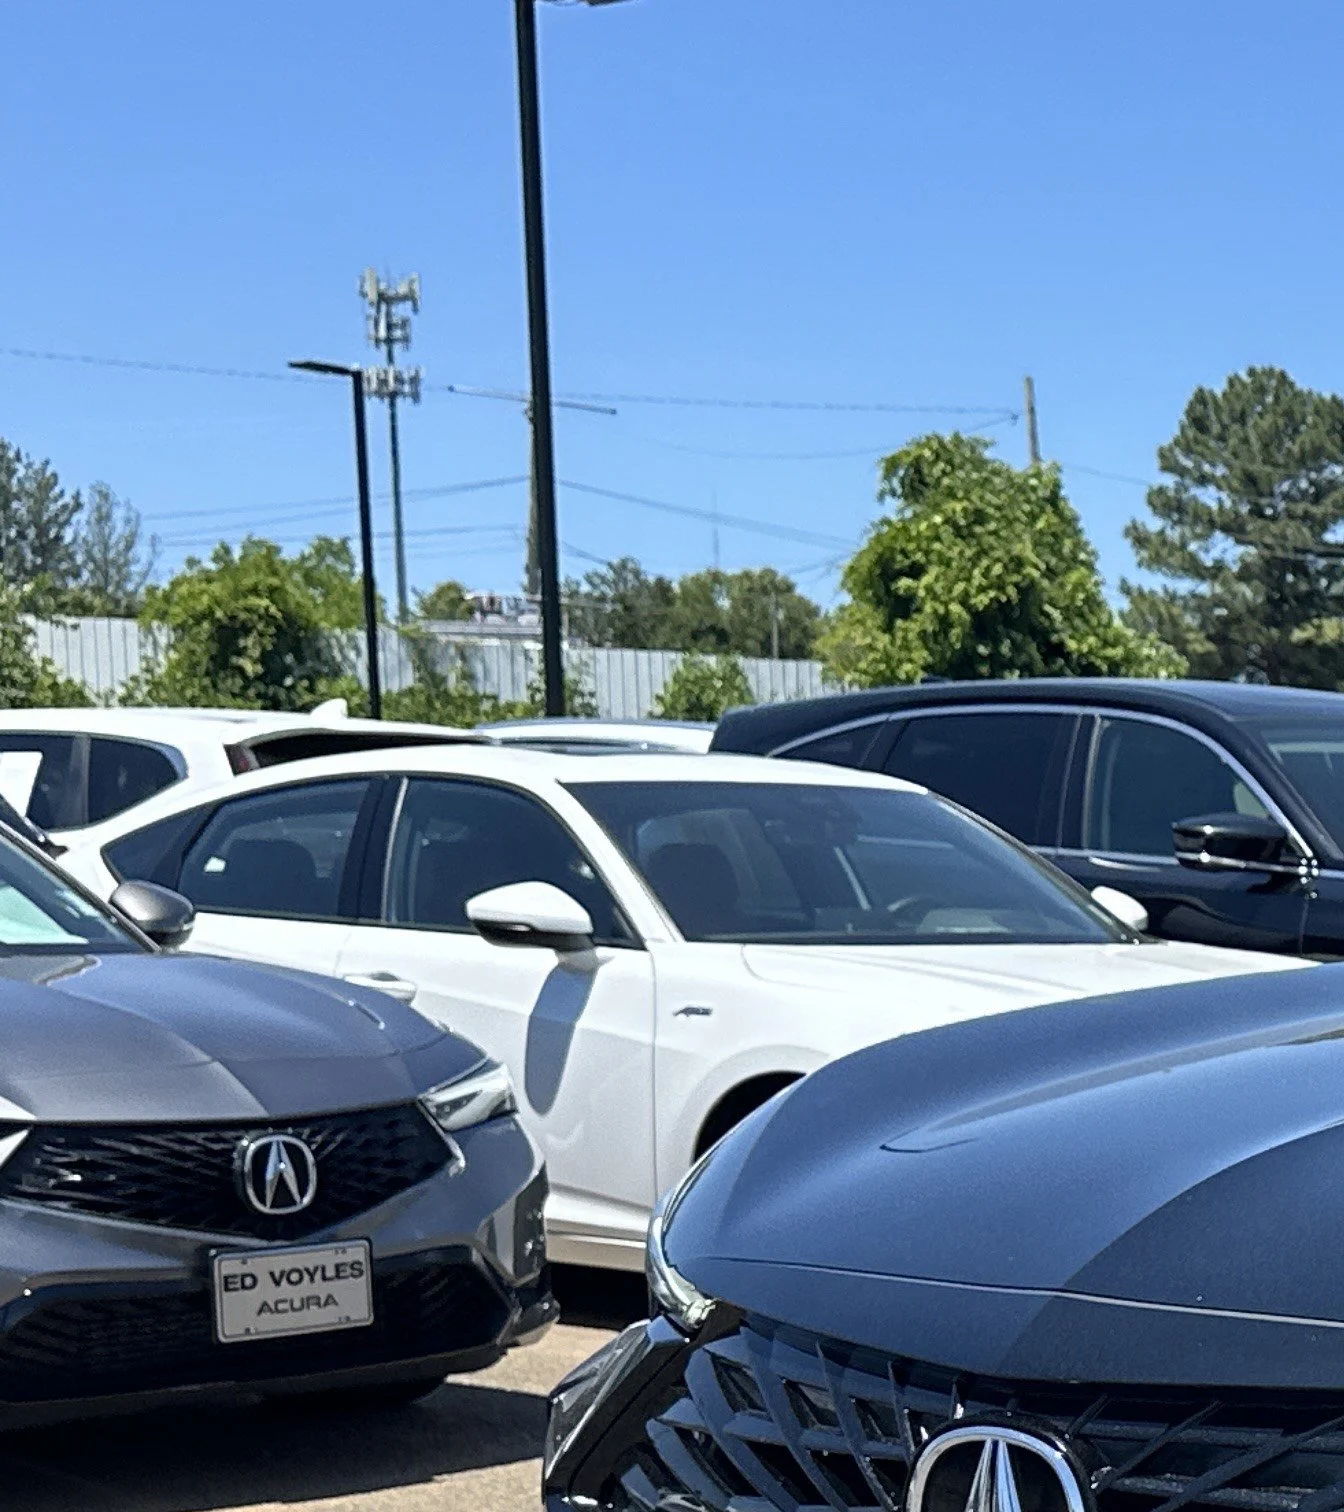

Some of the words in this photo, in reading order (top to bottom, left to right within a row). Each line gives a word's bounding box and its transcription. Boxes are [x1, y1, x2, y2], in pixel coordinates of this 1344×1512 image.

[223, 1272, 259, 1293] ED
[268, 1259, 365, 1288] VOYLES
[256, 1293, 340, 1317] ACURA
